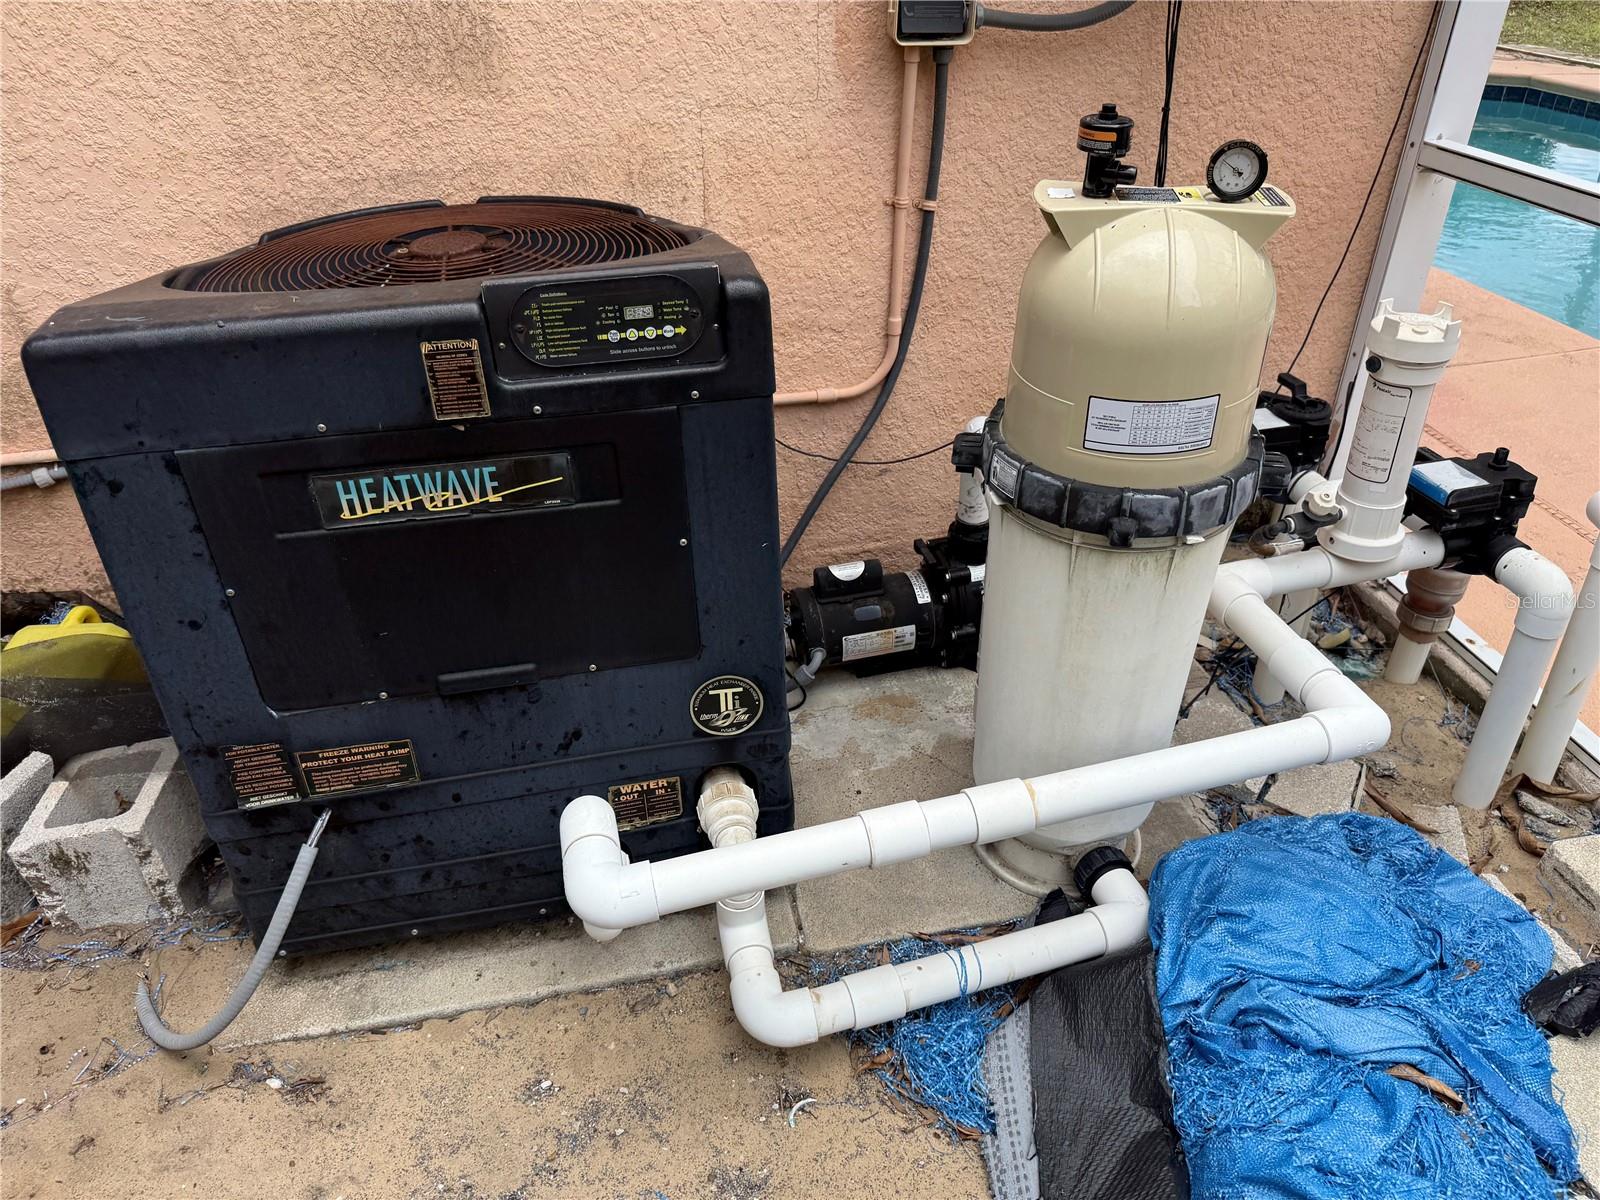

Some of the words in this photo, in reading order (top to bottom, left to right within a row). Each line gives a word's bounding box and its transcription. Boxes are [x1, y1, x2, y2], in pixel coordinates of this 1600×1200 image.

[428, 342, 472, 351] ATTENTION
[336, 466, 502, 518] HEATWAVE
[319, 749, 350, 758] FREEZE
[351, 744, 390, 753] WARNING
[301, 759, 338, 769] PROTECT
[341, 755, 363, 763] YOUR
[620, 780, 668, 794] WATER
[620, 793, 639, 801] OUT
